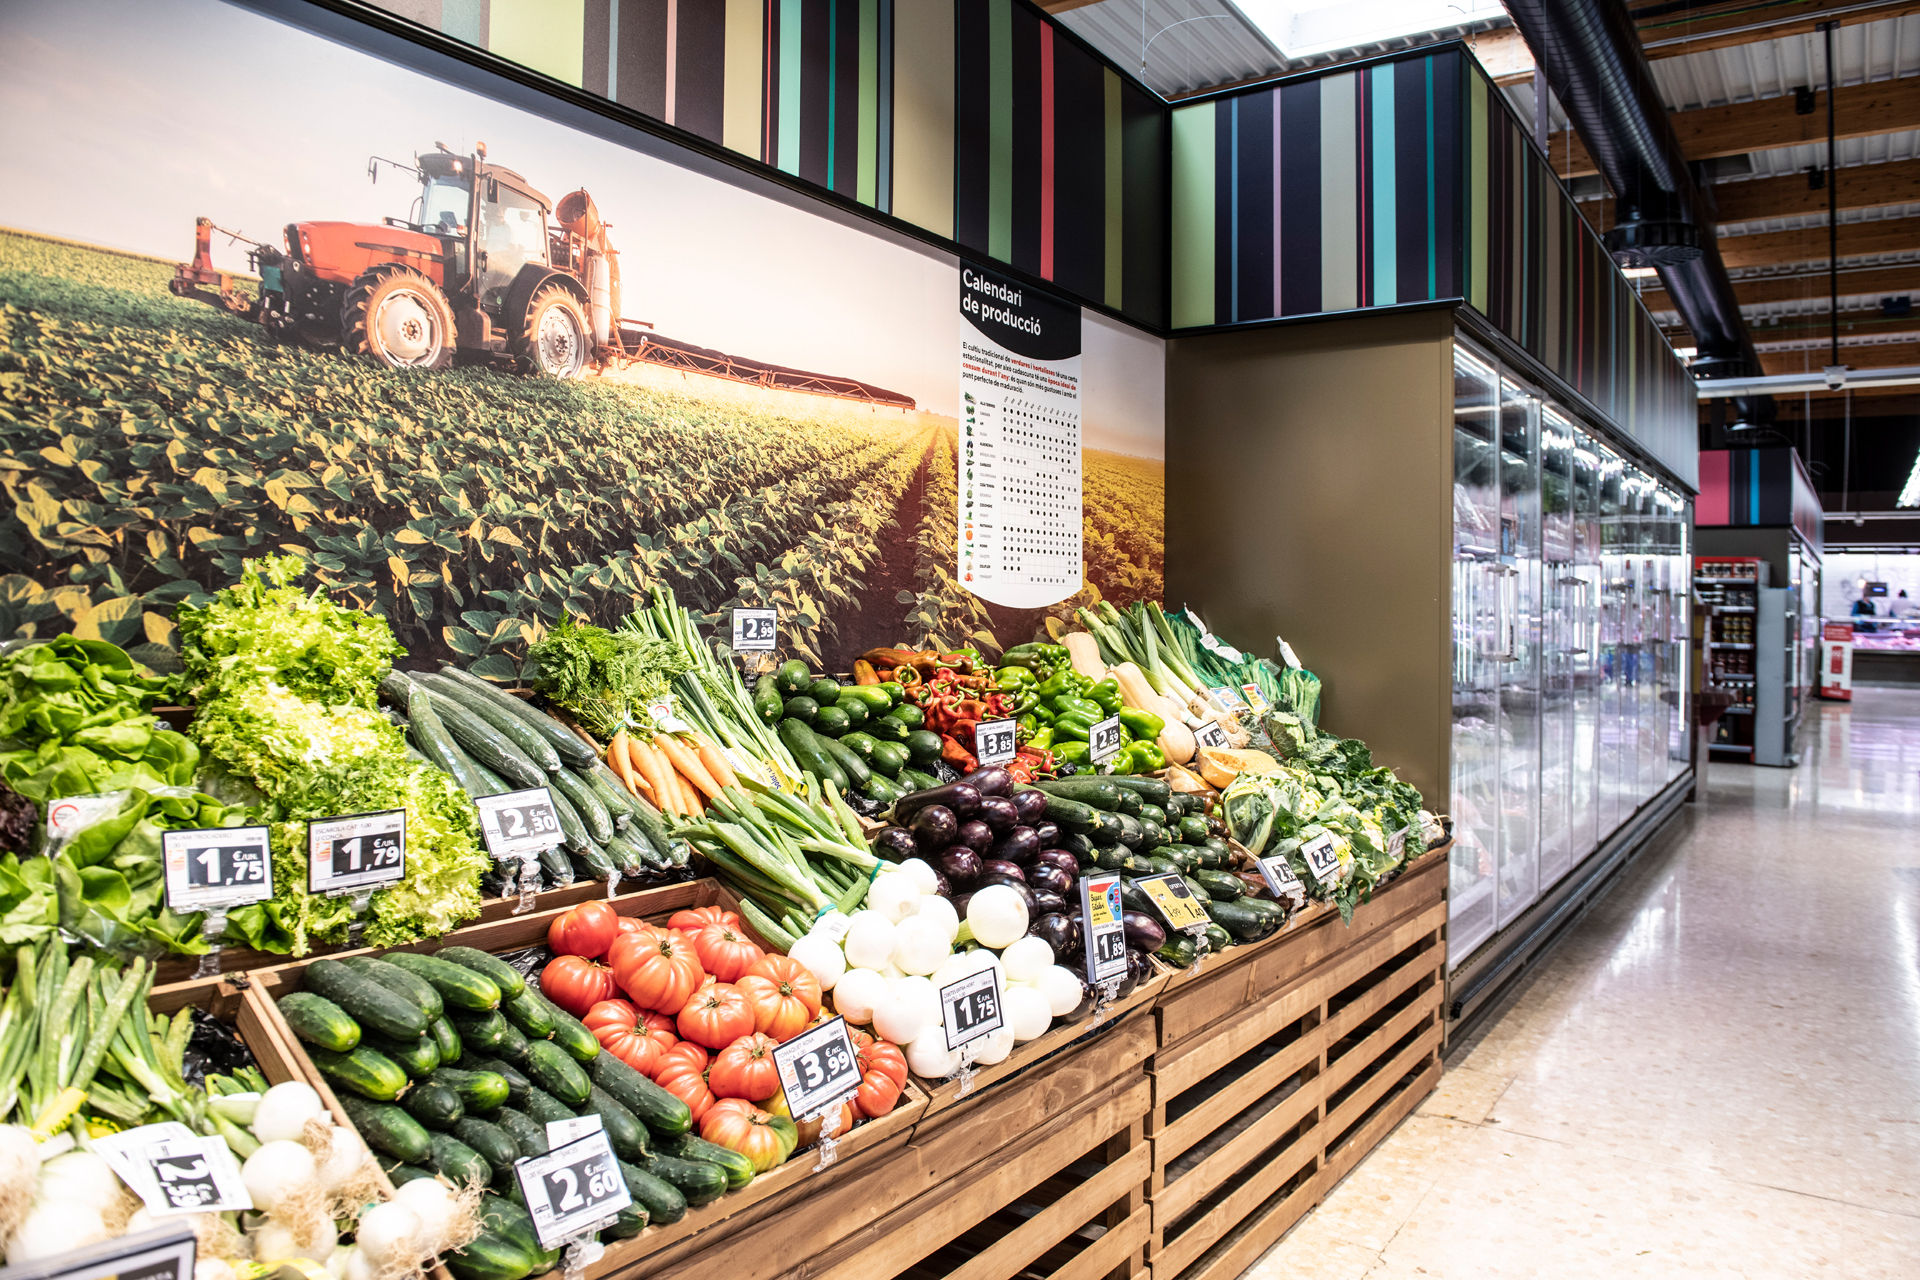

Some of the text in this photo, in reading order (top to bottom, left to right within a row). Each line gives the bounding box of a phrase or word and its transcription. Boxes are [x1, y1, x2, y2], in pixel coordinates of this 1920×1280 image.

[963, 269, 1022, 307] Calendari
[963, 293, 1041, 335] de producció
[963, 352, 994, 367] estacionalitat,
[1003, 363, 1011, 372] això
[1013, 367, 1034, 378] cadascuna
[1061, 381, 1070, 389] ideal
[968, 343, 980, 354] cultiu
[982, 348, 1004, 361] tradicional
[1011, 357, 1030, 369] verdures
[1033, 364, 1055, 376] hortalisses
[963, 371, 973, 380] punt
[974, 374, 992, 386] perfecte
[963, 362, 981, 372] consum
[982, 366, 997, 377] durant
[1017, 378, 1026, 386] quan
[1045, 386, 1061, 397] gustoses
[746, 619, 773, 639] 2,99
[988, 734, 1011, 754] 3,85
[1100, 731, 1118, 748] 2,59
[316, 826, 345, 834] ESCAROLA
[502, 809, 556, 836] 2,30
[233, 851, 258, 861] €/UN.
[342, 838, 399, 871] 1,79
[374, 838, 395, 848] €/UN.
[196, 848, 264, 885] 1,75
[1314, 850, 1335, 868] 2,49
[1100, 935, 1123, 960] 1,89
[959, 996, 995, 1025] 1,75
[803, 1037, 814, 1046] ROSA
[780, 1055, 796, 1066] CONCA
[800, 1051, 850, 1087] 3,99
[584, 1162, 606, 1176] €/KG.
[157, 1159, 210, 1207] 2,59
[551, 1168, 618, 1212] 2,60
